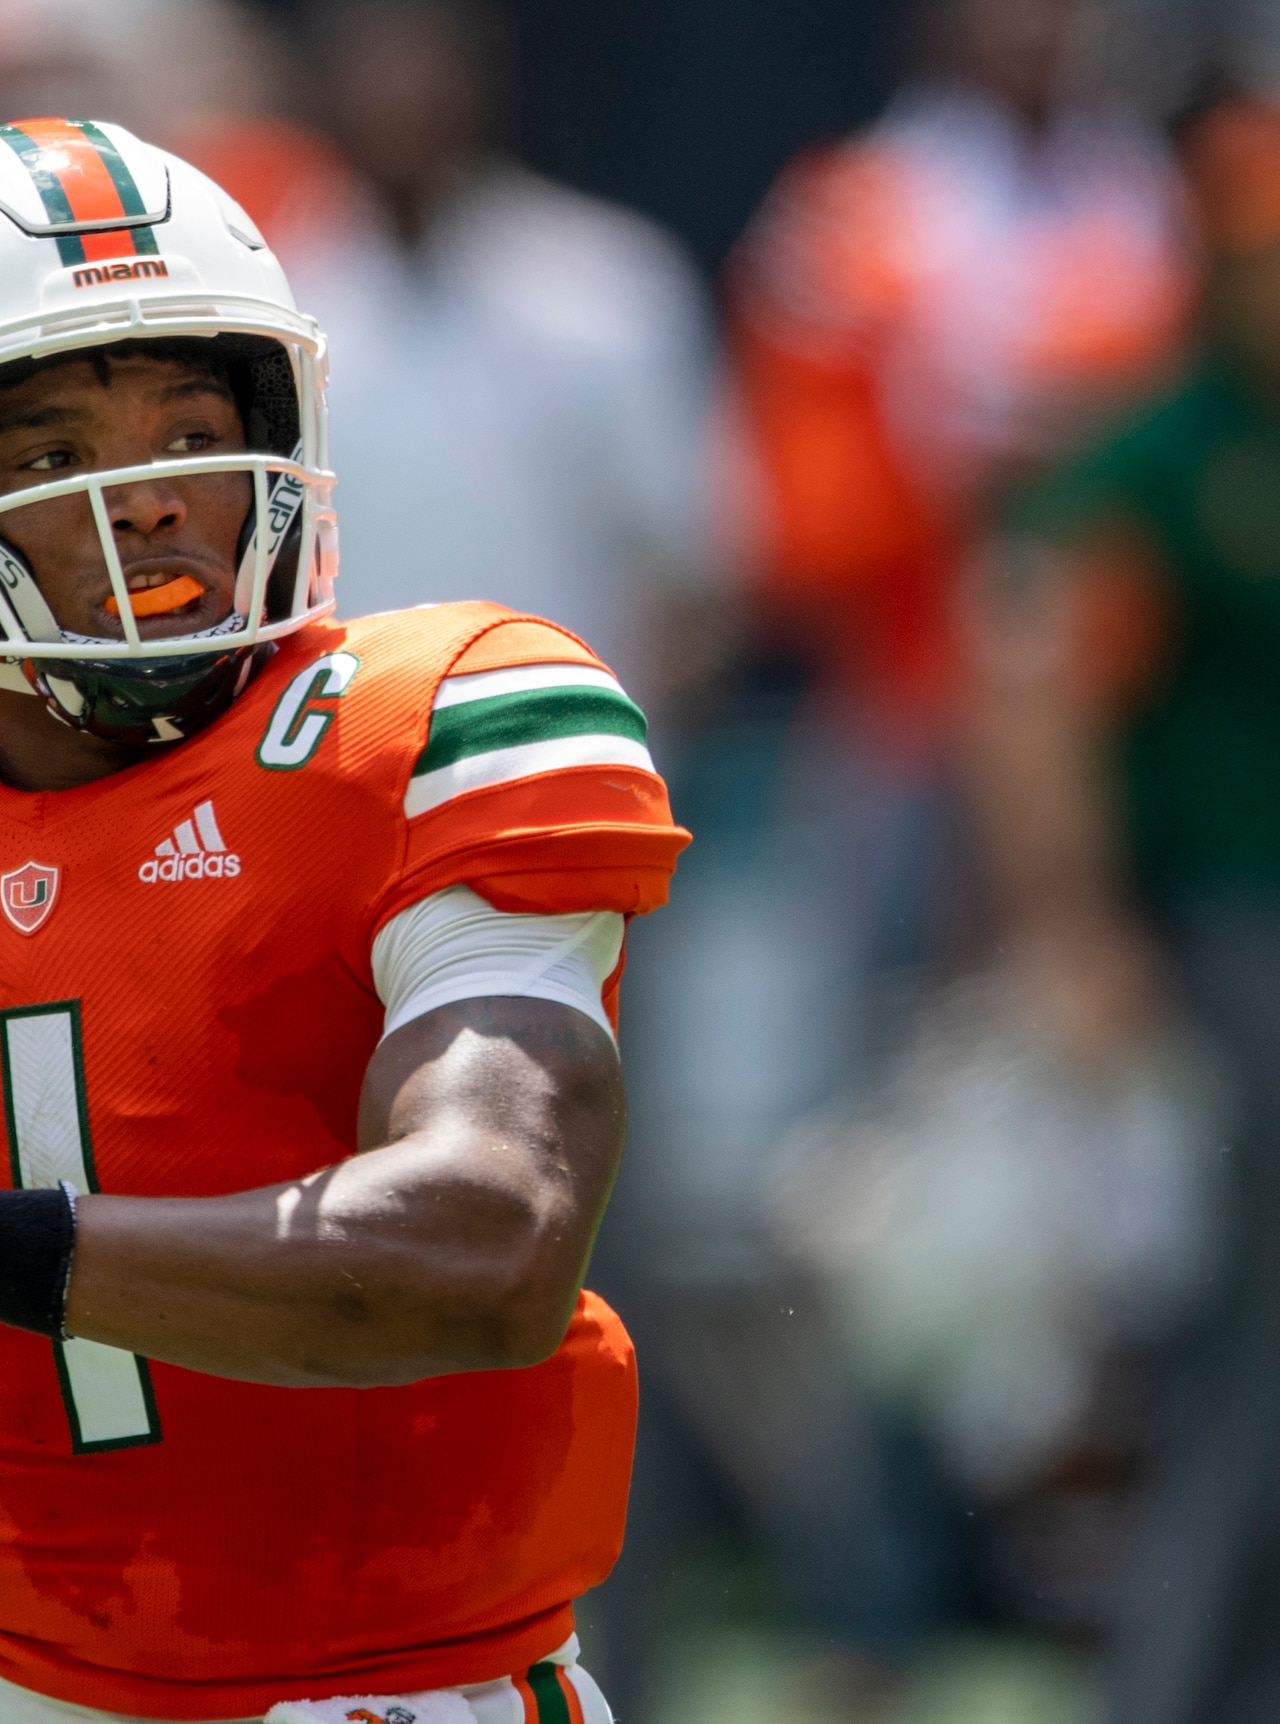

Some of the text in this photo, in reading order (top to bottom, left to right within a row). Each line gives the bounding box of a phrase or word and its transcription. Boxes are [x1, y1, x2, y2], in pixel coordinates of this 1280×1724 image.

[255, 651, 361, 771] C
[138, 851, 240, 883] adidas
[10, 879, 48, 909] U
